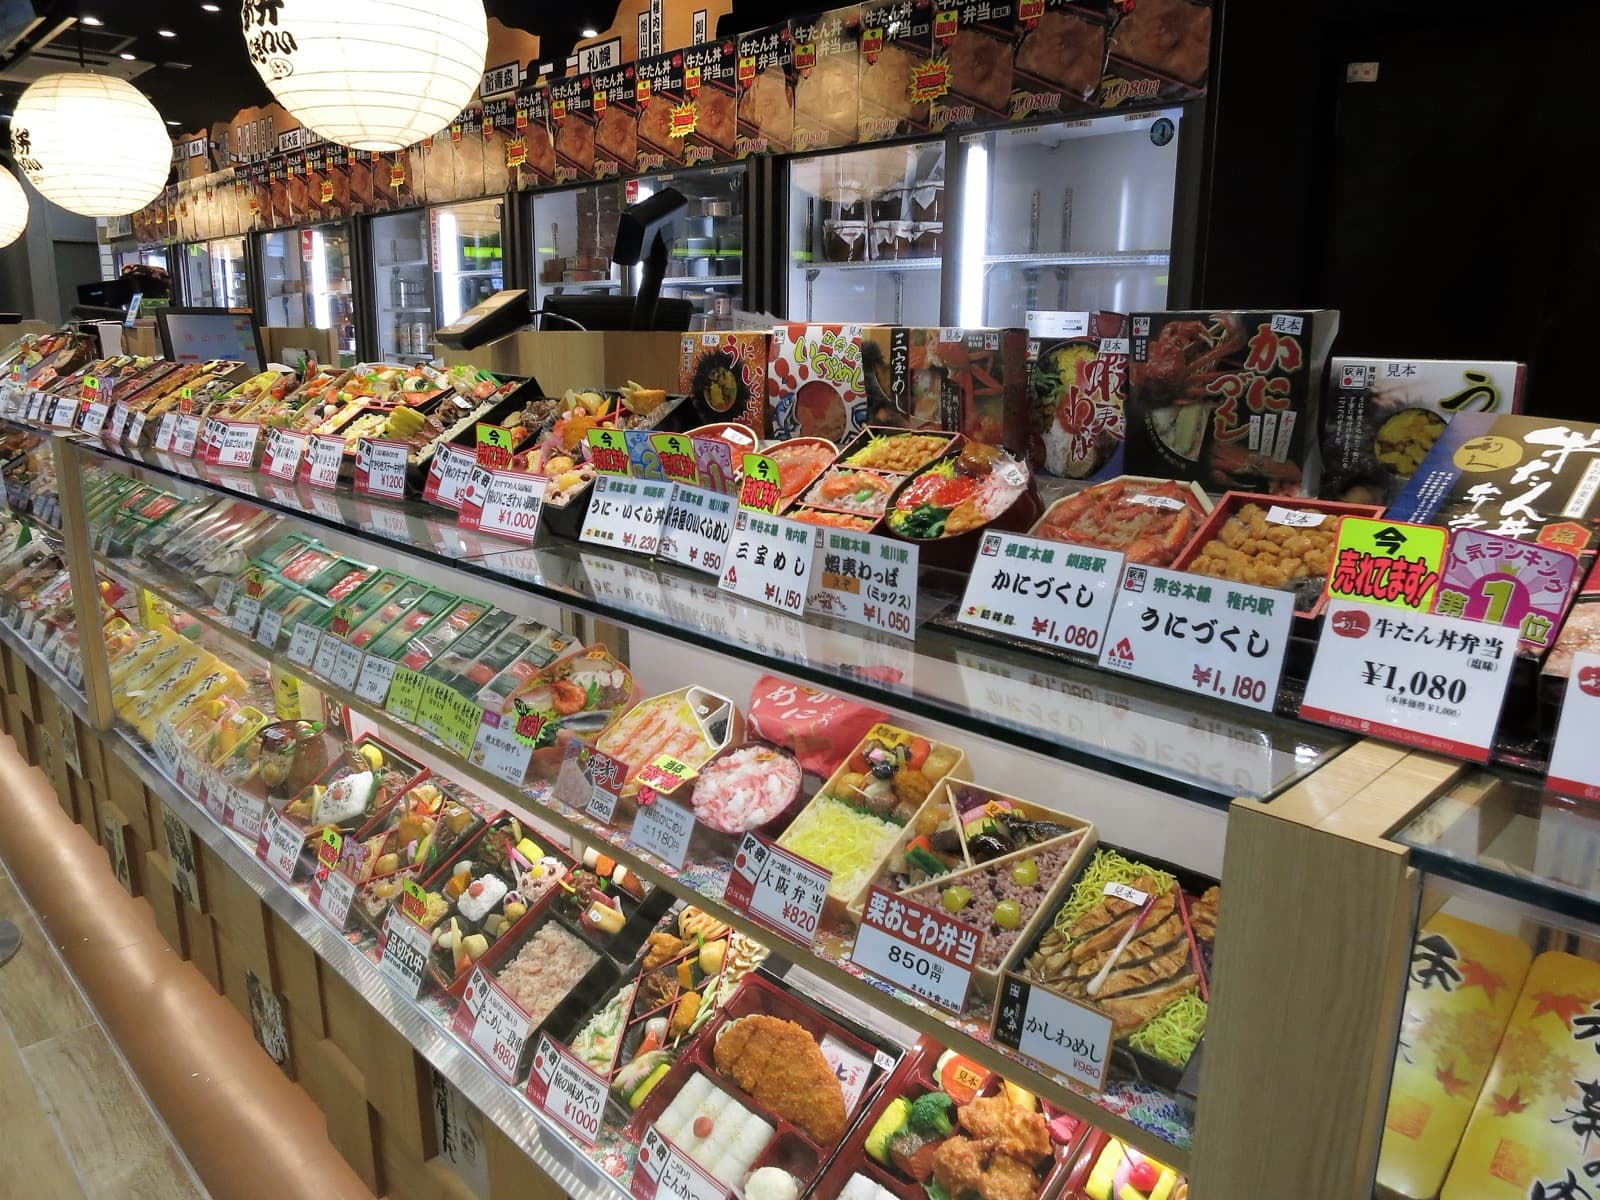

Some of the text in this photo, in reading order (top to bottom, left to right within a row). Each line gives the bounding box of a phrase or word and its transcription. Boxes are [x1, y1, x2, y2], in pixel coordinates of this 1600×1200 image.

[865, 1, 914, 27] 牛たん丼
[963, 4, 990, 24] 弁当
[794, 19, 842, 43] 牛たん丼
[886, 20, 912, 41] 弁当
[740, 33, 780, 56] 牛たん丼
[817, 38, 842, 57] 弁当
[587, 45, 611, 72] 札幌
[686, 46, 722, 68] 牛たん丼
[758, 51, 778, 70] 弁当
[595, 71, 625, 90] 牛たん丼
[639, 60, 672, 79] 牛たん丼
[703, 63, 722, 81] 弁当
[608, 86, 624, 102] 弁当
[653, 75, 671, 92] 弁当
[1106, 79, 1161, 100] 1,080円
[1273, 316, 1301, 332] 見本
[703, 335, 718, 345] 見本
[1103, 339, 1122, 351] 見本
[891, 332, 909, 415] 三宝めし
[1244, 323, 1303, 413] かに
[1386, 363, 1416, 377] 見本
[1206, 371, 1255, 441] づくし
[489, 429, 500, 444] 今
[600, 432, 612, 448] 今
[668, 437, 680, 452] 今
[757, 460, 769, 478] 今
[591, 498, 667, 526] うに・いくら丼
[622, 531, 657, 551] ¥1,230
[1373, 527, 1408, 555] 今
[736, 542, 805, 576] 三宝めし
[880, 544, 909, 565] 旭川駅
[1065, 552, 1107, 573] 釧路駅
[1332, 548, 1440, 608] 売れてます!
[1449, 539, 1570, 594] 人気ランキング
[764, 582, 802, 610] ¥1,150
[991, 569, 1094, 608] かにづくし
[1153, 576, 1275, 617] 宗谷本線 稚内駅
[863, 602, 911, 634] ¥1,050
[1031, 616, 1099, 649] ¥1,080
[1140, 605, 1270, 658] うにづくし
[1374, 617, 1505, 660] 牛たん丼弁当
[1191, 663, 1267, 703] ¥1,180
[1361, 660, 1468, 704] ¥1,080
[760, 868, 823, 914] 大阪弁当
[1114, 884, 1135, 899] 見本
[782, 900, 816, 932] ¥820
[866, 890, 978, 965] 栗おこわ弁当
[386, 932, 424, 974] 品切れ中
[1025, 1016, 1103, 1063] かしわめし
[493, 1037, 517, 1071] ¥980
[876, 1054, 891, 1067] 見本
[958, 1070, 979, 1087] 見本
[1072, 1058, 1101, 1079] ¥980
[563, 1099, 598, 1134] ¥1000
